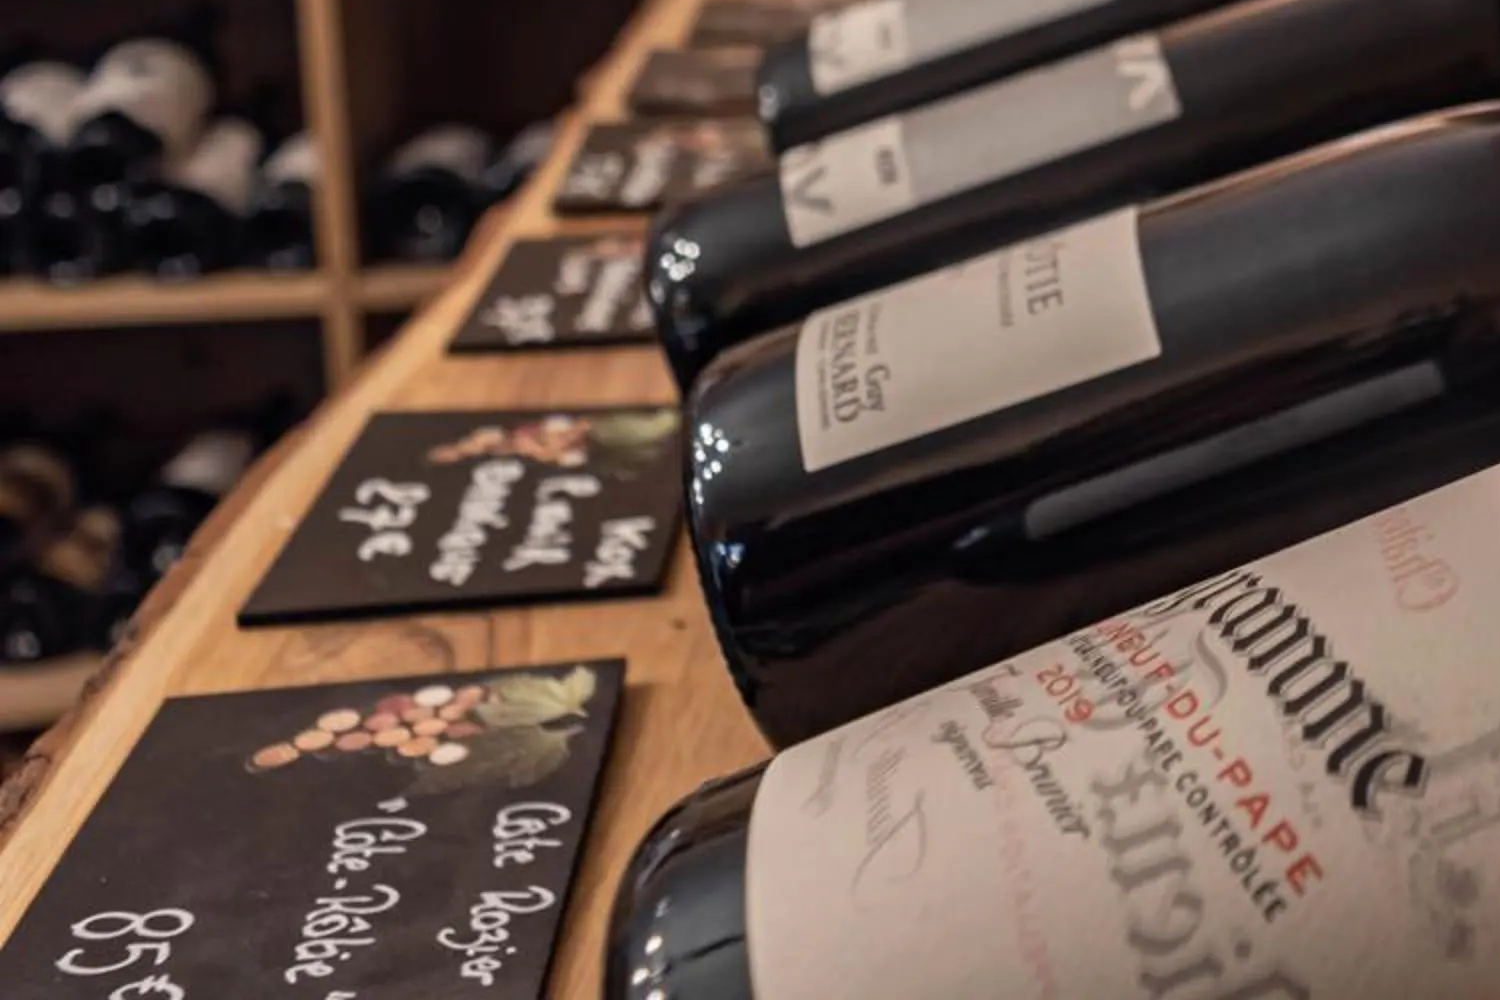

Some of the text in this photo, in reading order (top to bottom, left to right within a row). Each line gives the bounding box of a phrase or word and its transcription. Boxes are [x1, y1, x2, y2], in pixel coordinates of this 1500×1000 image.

[862, 361, 892, 414] Guy
[1036, 665, 1095, 724] 2019
[984, 716, 1092, 838] Brunier
[1175, 770, 1289, 924] CONTRÔLÉE
[56, 909, 194, 1000] 85€
[437, 885, 556, 986] Rozier
